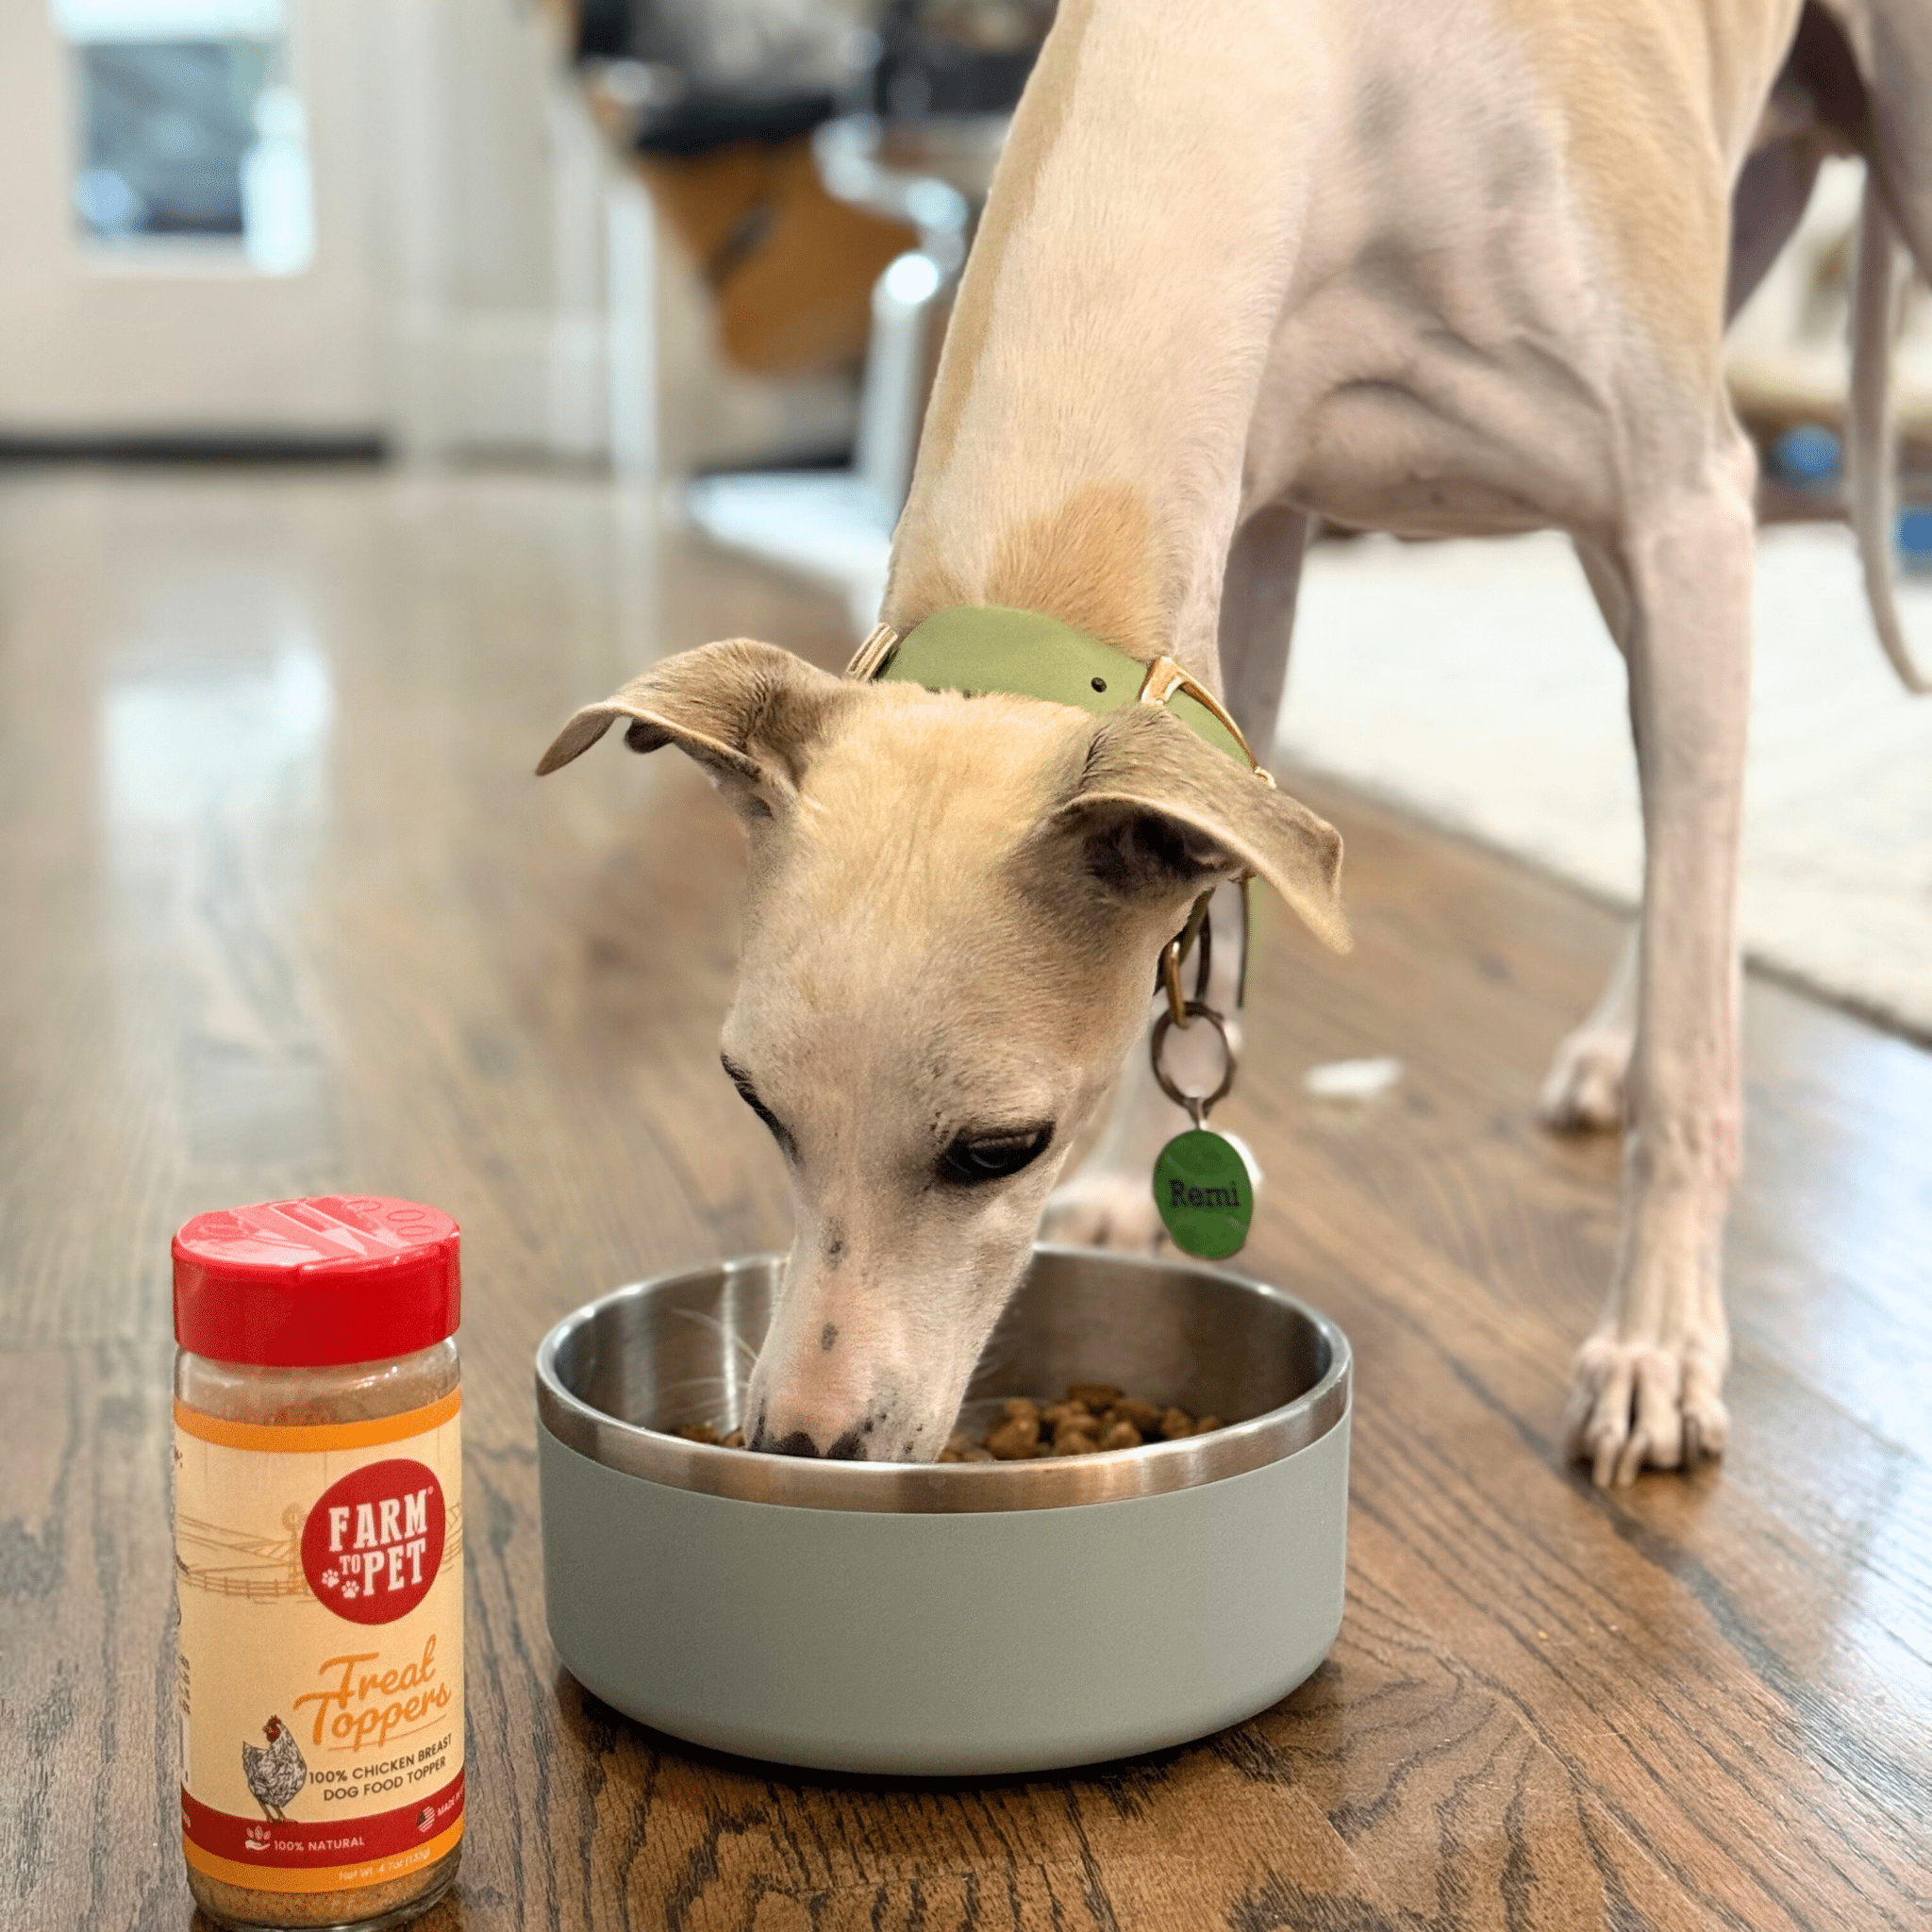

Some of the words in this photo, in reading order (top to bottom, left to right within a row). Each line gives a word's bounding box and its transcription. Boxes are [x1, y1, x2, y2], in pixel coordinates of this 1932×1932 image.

[1168, 1178, 1240, 1208] Remi
[328, 1489, 427, 1553] FARM
[340, 1554, 361, 1575] TO
[362, 1538, 426, 1597] PET
[319, 1633, 437, 1709] Treat
[292, 1682, 452, 1752] Toppers
[309, 1770, 347, 1785] 100%
[352, 1754, 414, 1780] CHICKEN
[418, 1732, 452, 1762] BREAST
[324, 1786, 359, 1801] DOG
[364, 1775, 404, 1796] FOOD
[407, 1756, 445, 1784] TOPPER
[274, 1840, 304, 1851] 100%
[308, 1836, 365, 1851] NATURAL
